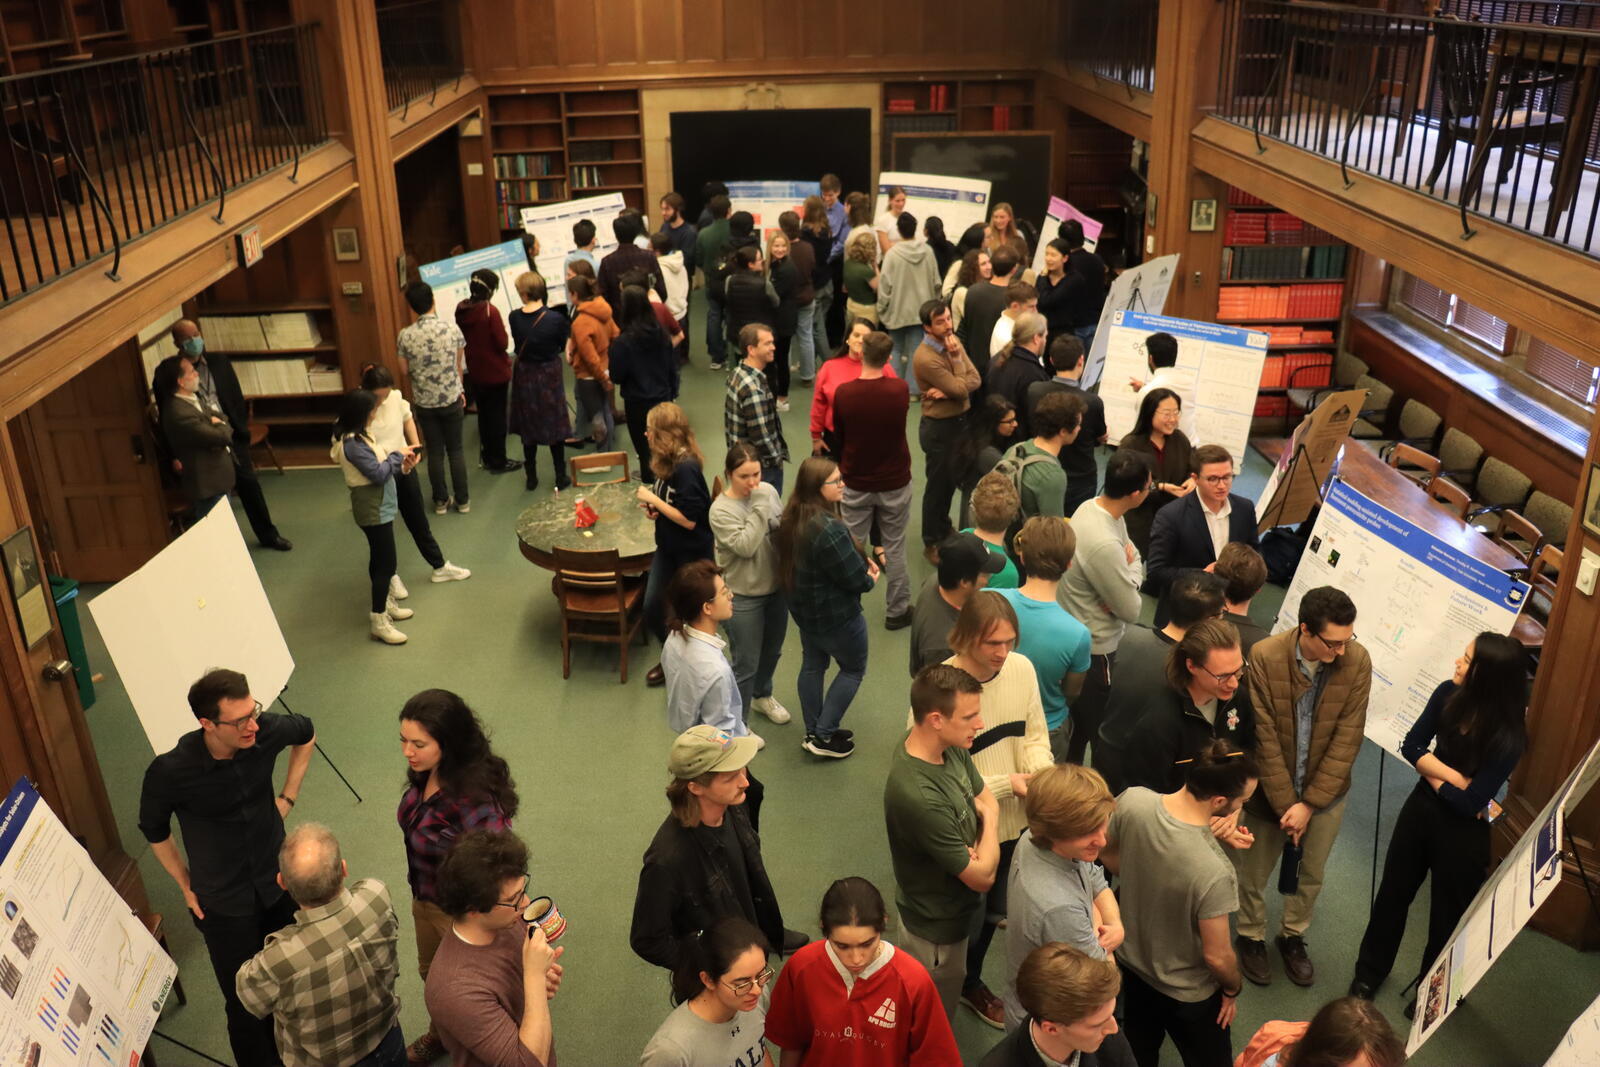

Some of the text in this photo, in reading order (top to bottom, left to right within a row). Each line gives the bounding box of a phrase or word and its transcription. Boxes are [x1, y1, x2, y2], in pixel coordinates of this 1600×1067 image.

[244, 231, 258, 262] EXIT
[423, 265, 441, 278] Yale
[1249, 335, 1266, 346] Yale
[158, 975, 173, 1003] ENERGY
[814, 1029, 842, 1039] OYAL
